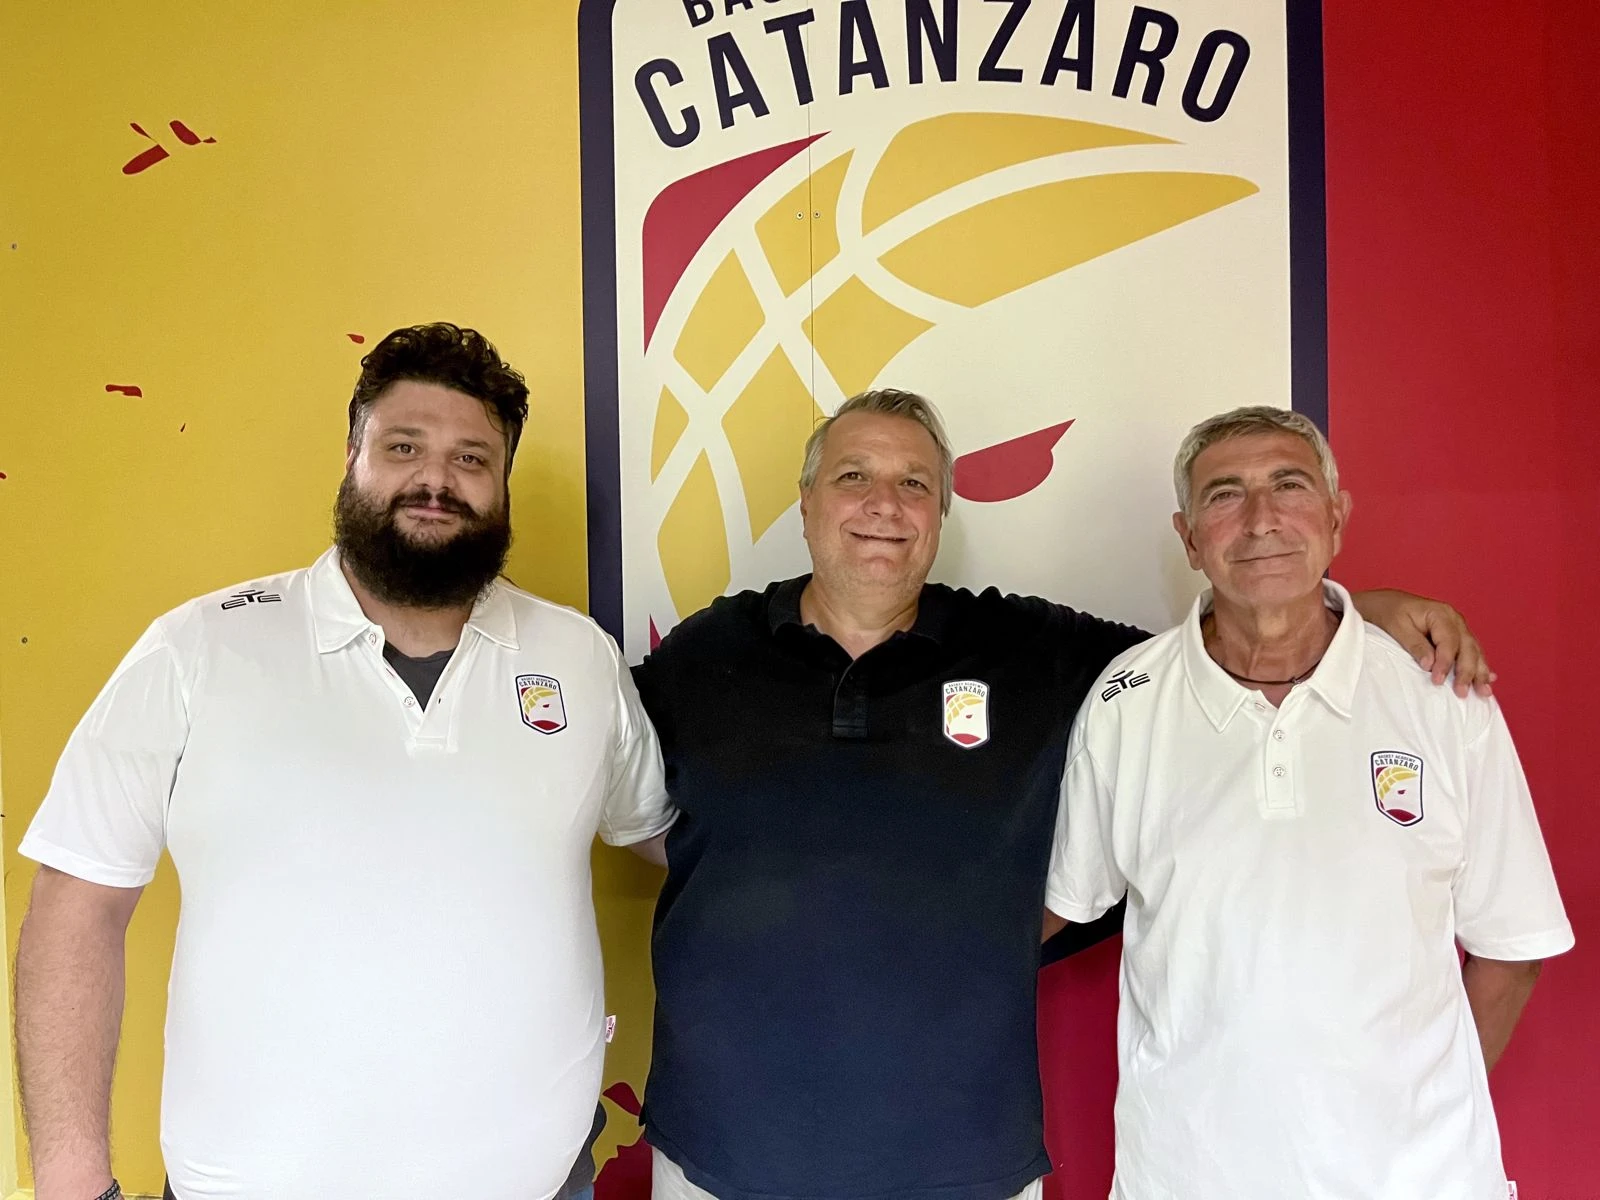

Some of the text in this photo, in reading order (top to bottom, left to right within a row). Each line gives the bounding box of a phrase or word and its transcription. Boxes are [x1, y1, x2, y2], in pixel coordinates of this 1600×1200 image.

[634, 0, 1251, 148] CATANZARO
[519, 680, 557, 690] CATANZARO
[945, 686, 985, 698] CATANZARO
[1375, 758, 1419, 771] CATANZARO
